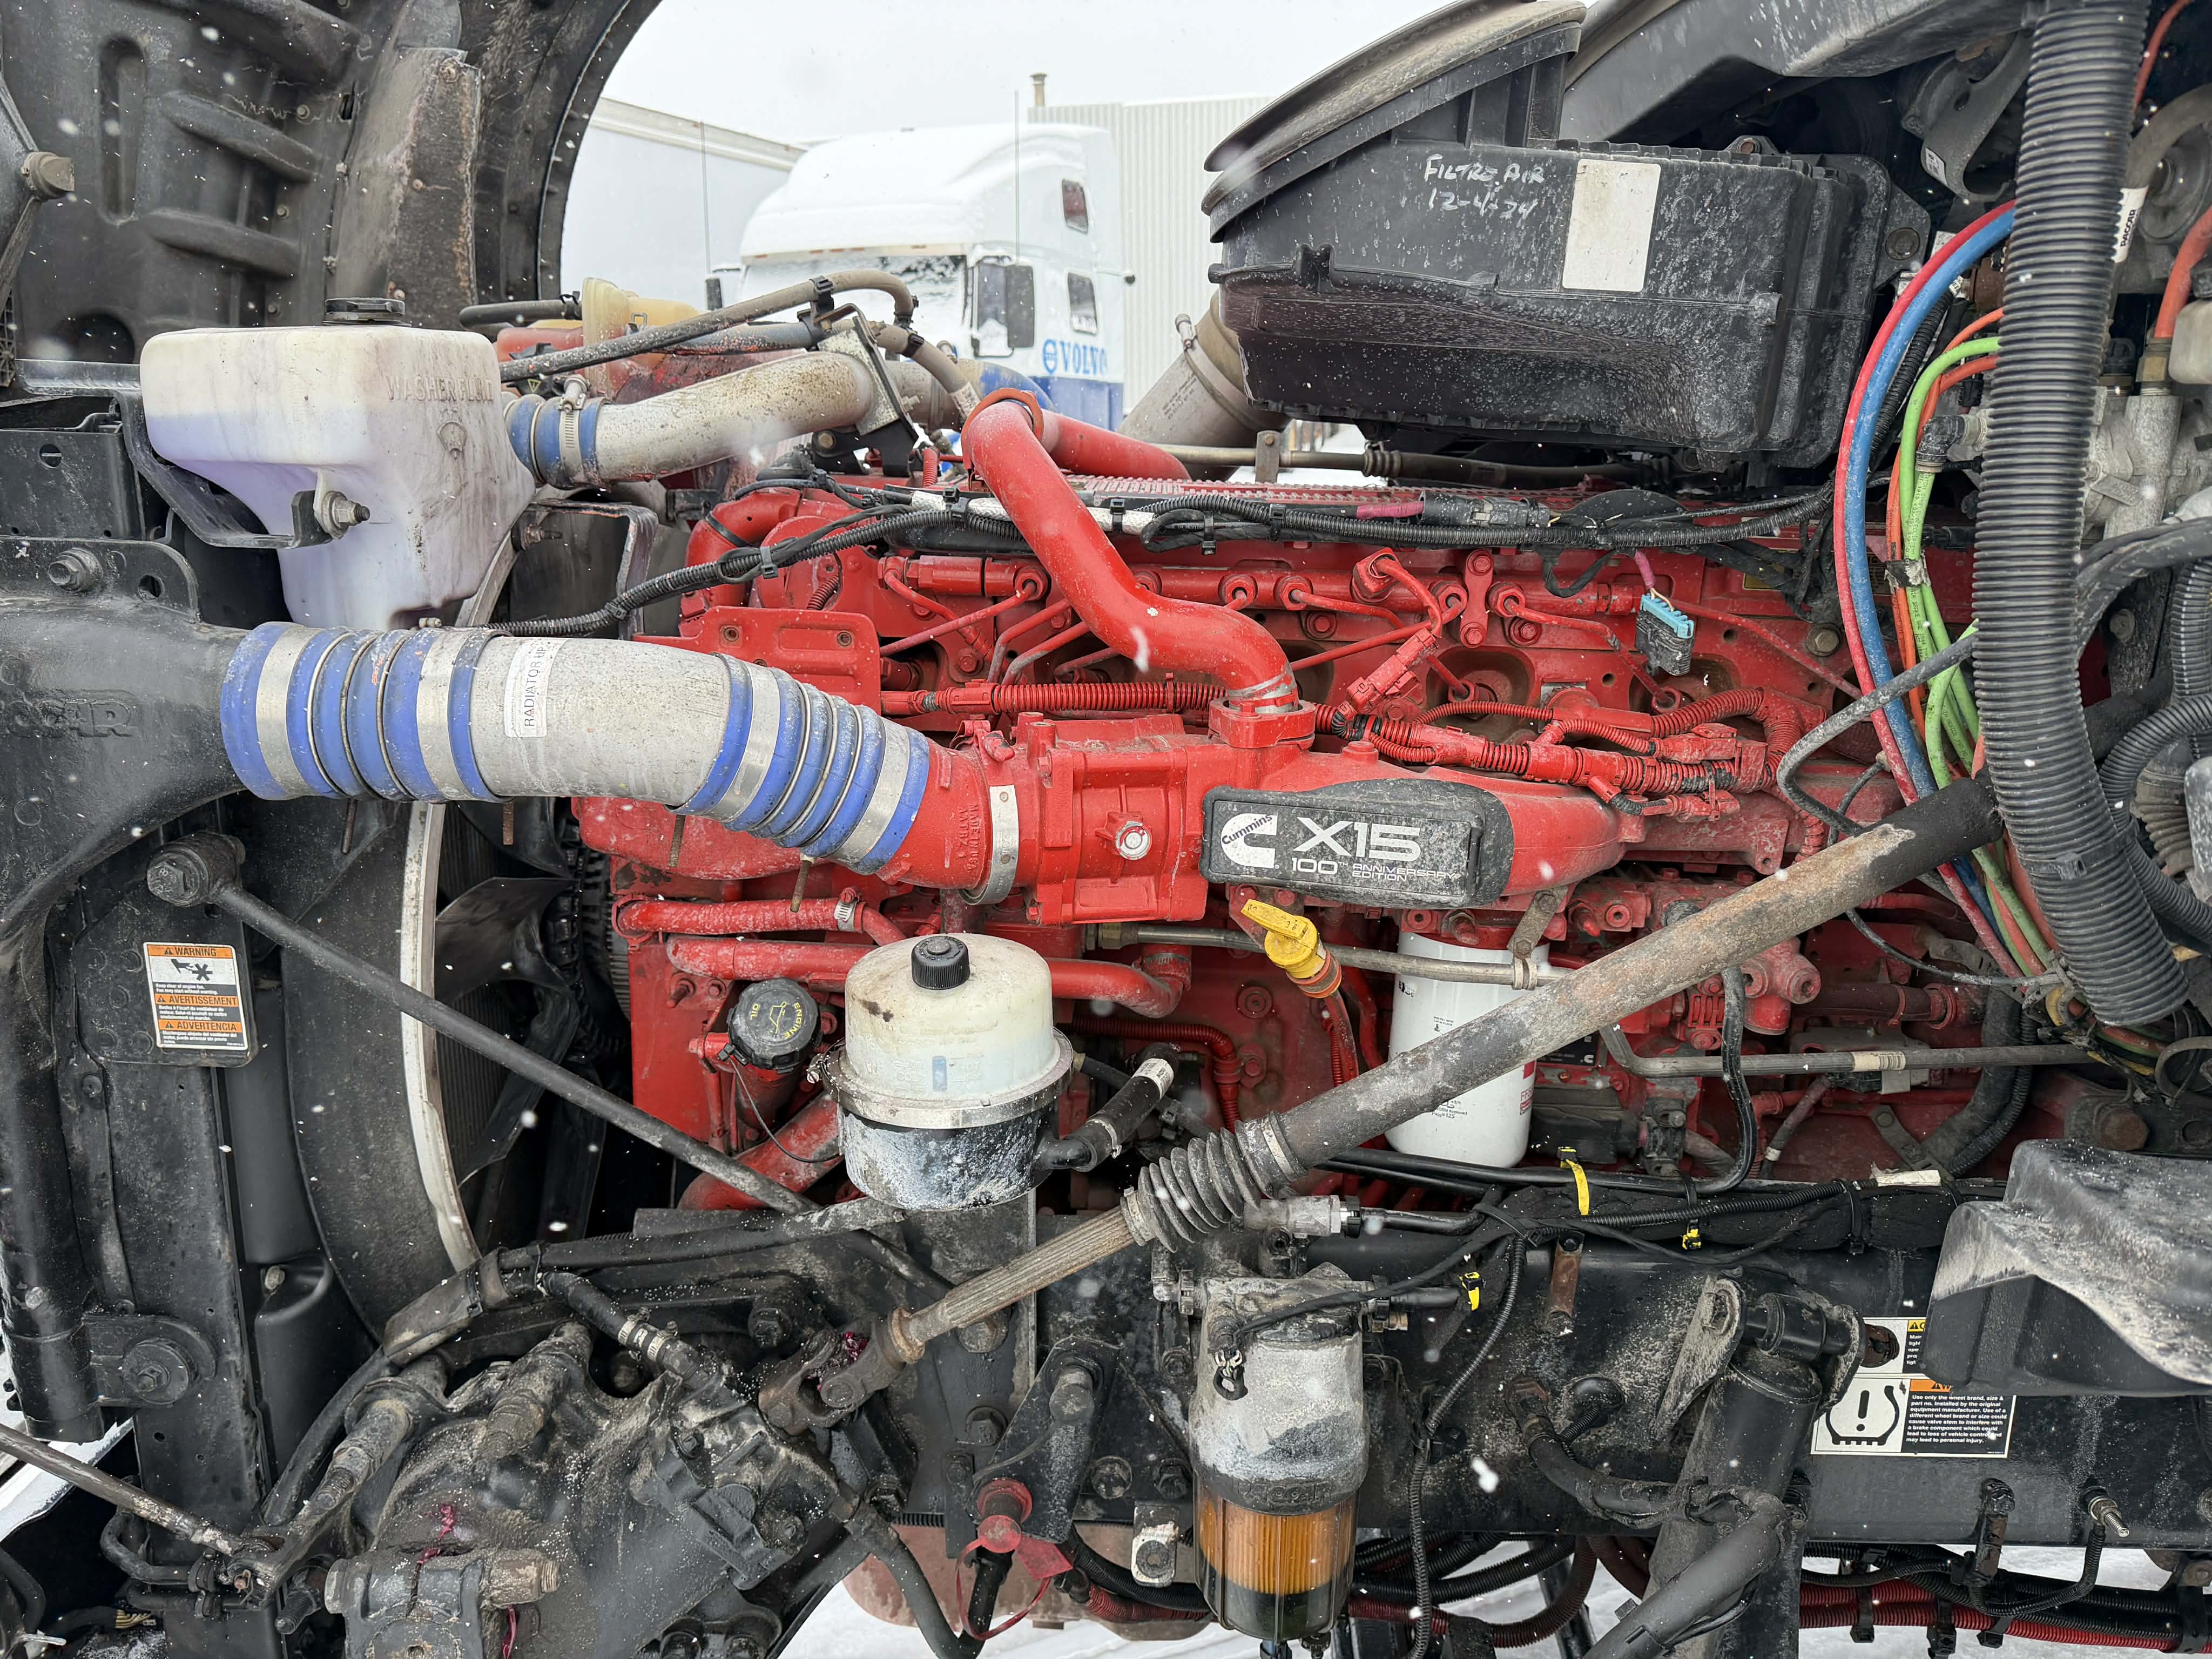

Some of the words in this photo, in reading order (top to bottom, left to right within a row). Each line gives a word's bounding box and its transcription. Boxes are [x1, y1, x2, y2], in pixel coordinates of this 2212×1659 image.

[1424, 153, 1498, 182] FILTRE
[1503, 163, 1546, 184] AIR
[2120, 209, 2136, 248] PACCAR
[1060, 341, 1109, 375] VOLVO
[386, 376, 457, 402] WASHER
[524, 661, 540, 727] RADIATOR
[1222, 813, 1273, 845] Cummins
[1292, 817, 1421, 861] X15
[1352, 864, 1462, 880] ANNIVERSARY
[1352, 871, 1407, 882] EDITION
[174, 947, 217, 956] WARNING
[169, 996, 237, 1006] AVERTISSEMENT
[750, 1003, 761, 1020] OIL
[177, 1021, 237, 1031] ADVERTENCIA
[783, 1002, 803, 1039] ENGINE
